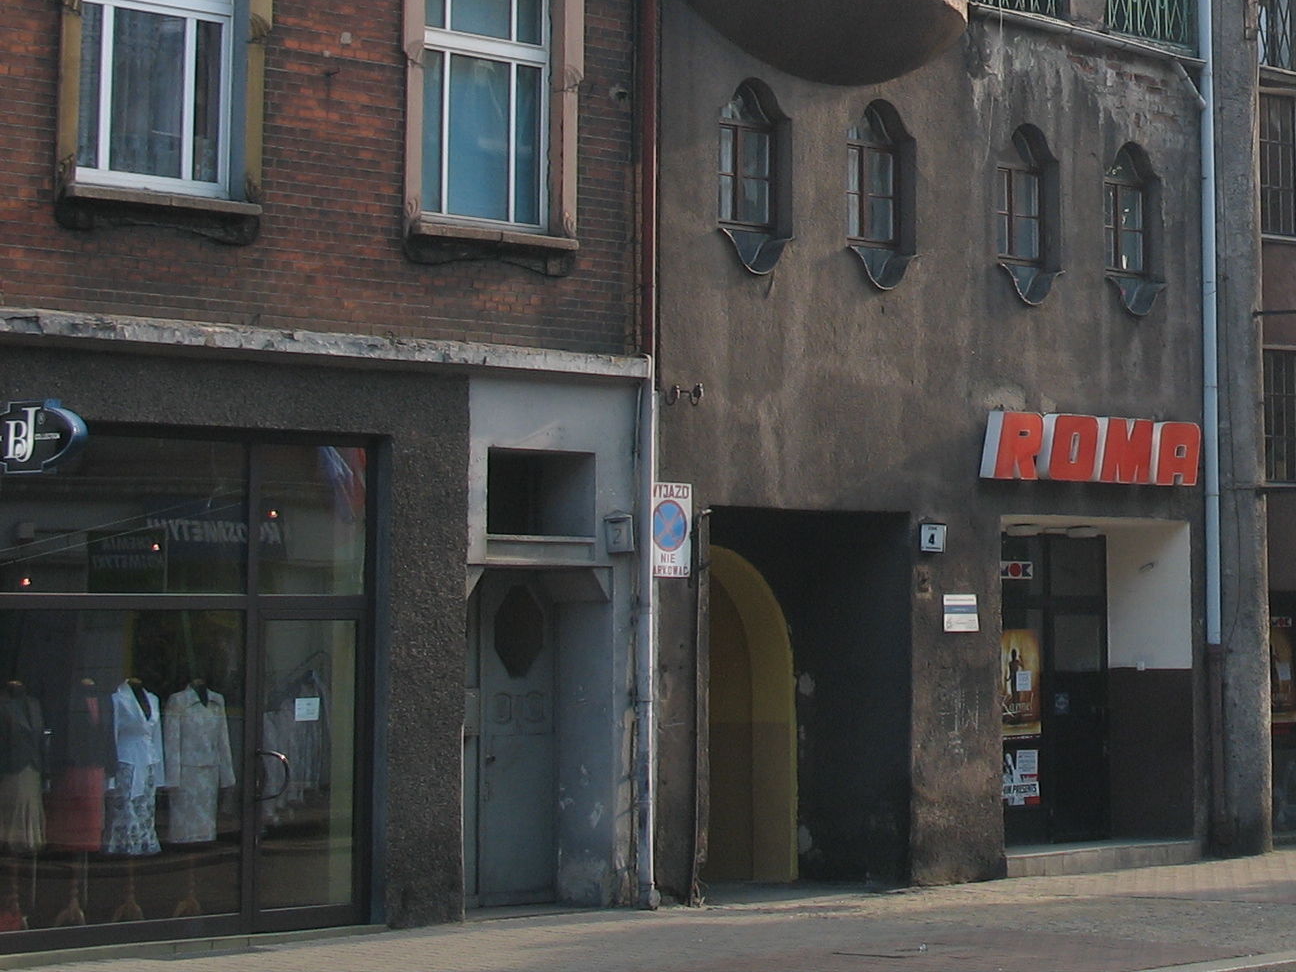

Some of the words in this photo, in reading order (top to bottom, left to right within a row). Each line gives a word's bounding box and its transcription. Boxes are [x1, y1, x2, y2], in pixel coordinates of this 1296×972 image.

[982, 410, 1202, 487] ROMA
[612, 528, 622, 545] 2
[928, 533, 935, 545] 4
[660, 553, 676, 563] NIE
[653, 563, 689, 576] ARKOWAĆ
